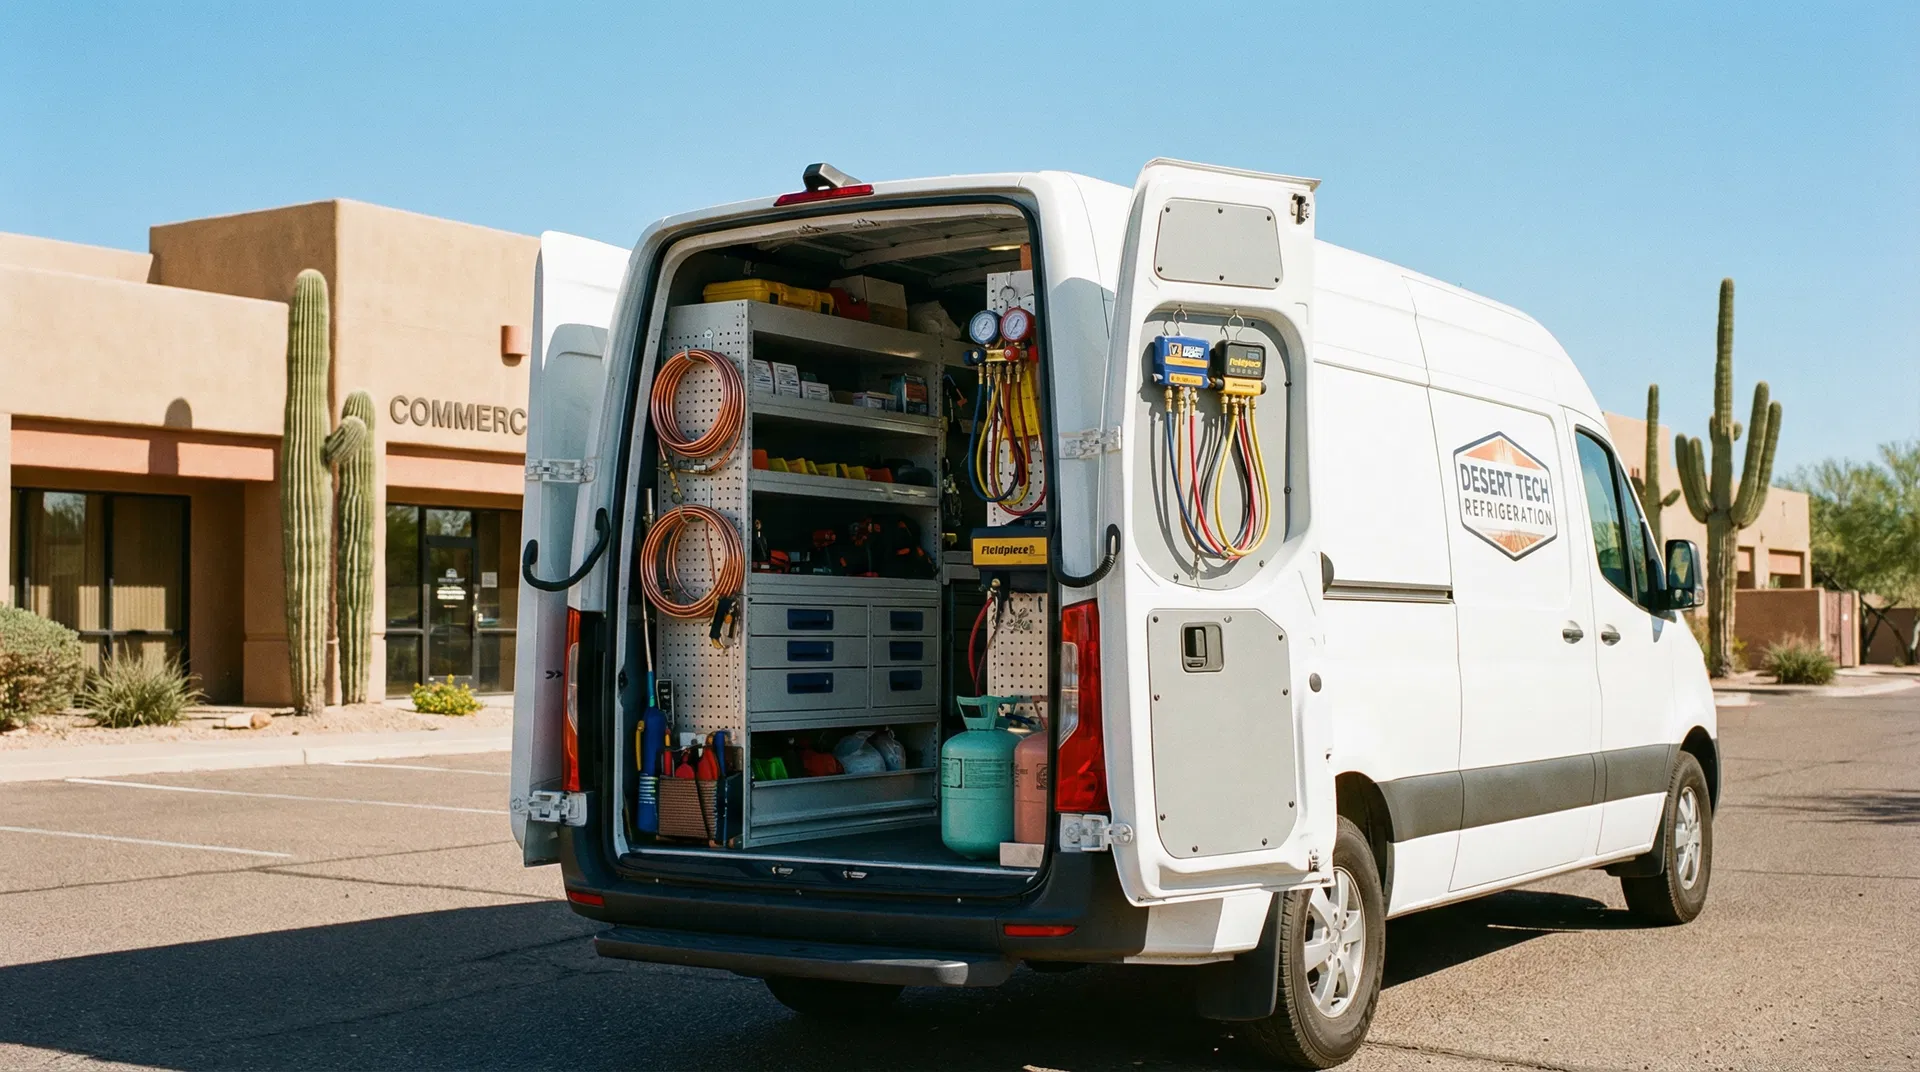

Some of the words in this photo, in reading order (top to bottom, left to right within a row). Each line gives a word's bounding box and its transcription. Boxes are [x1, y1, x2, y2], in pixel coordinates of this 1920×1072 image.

[389, 395, 527, 435] COMMERC
[1460, 463, 1513, 498] DESERT
[1516, 474, 1550, 504] TECH
[1465, 498, 1553, 526] REFRIGERATION
